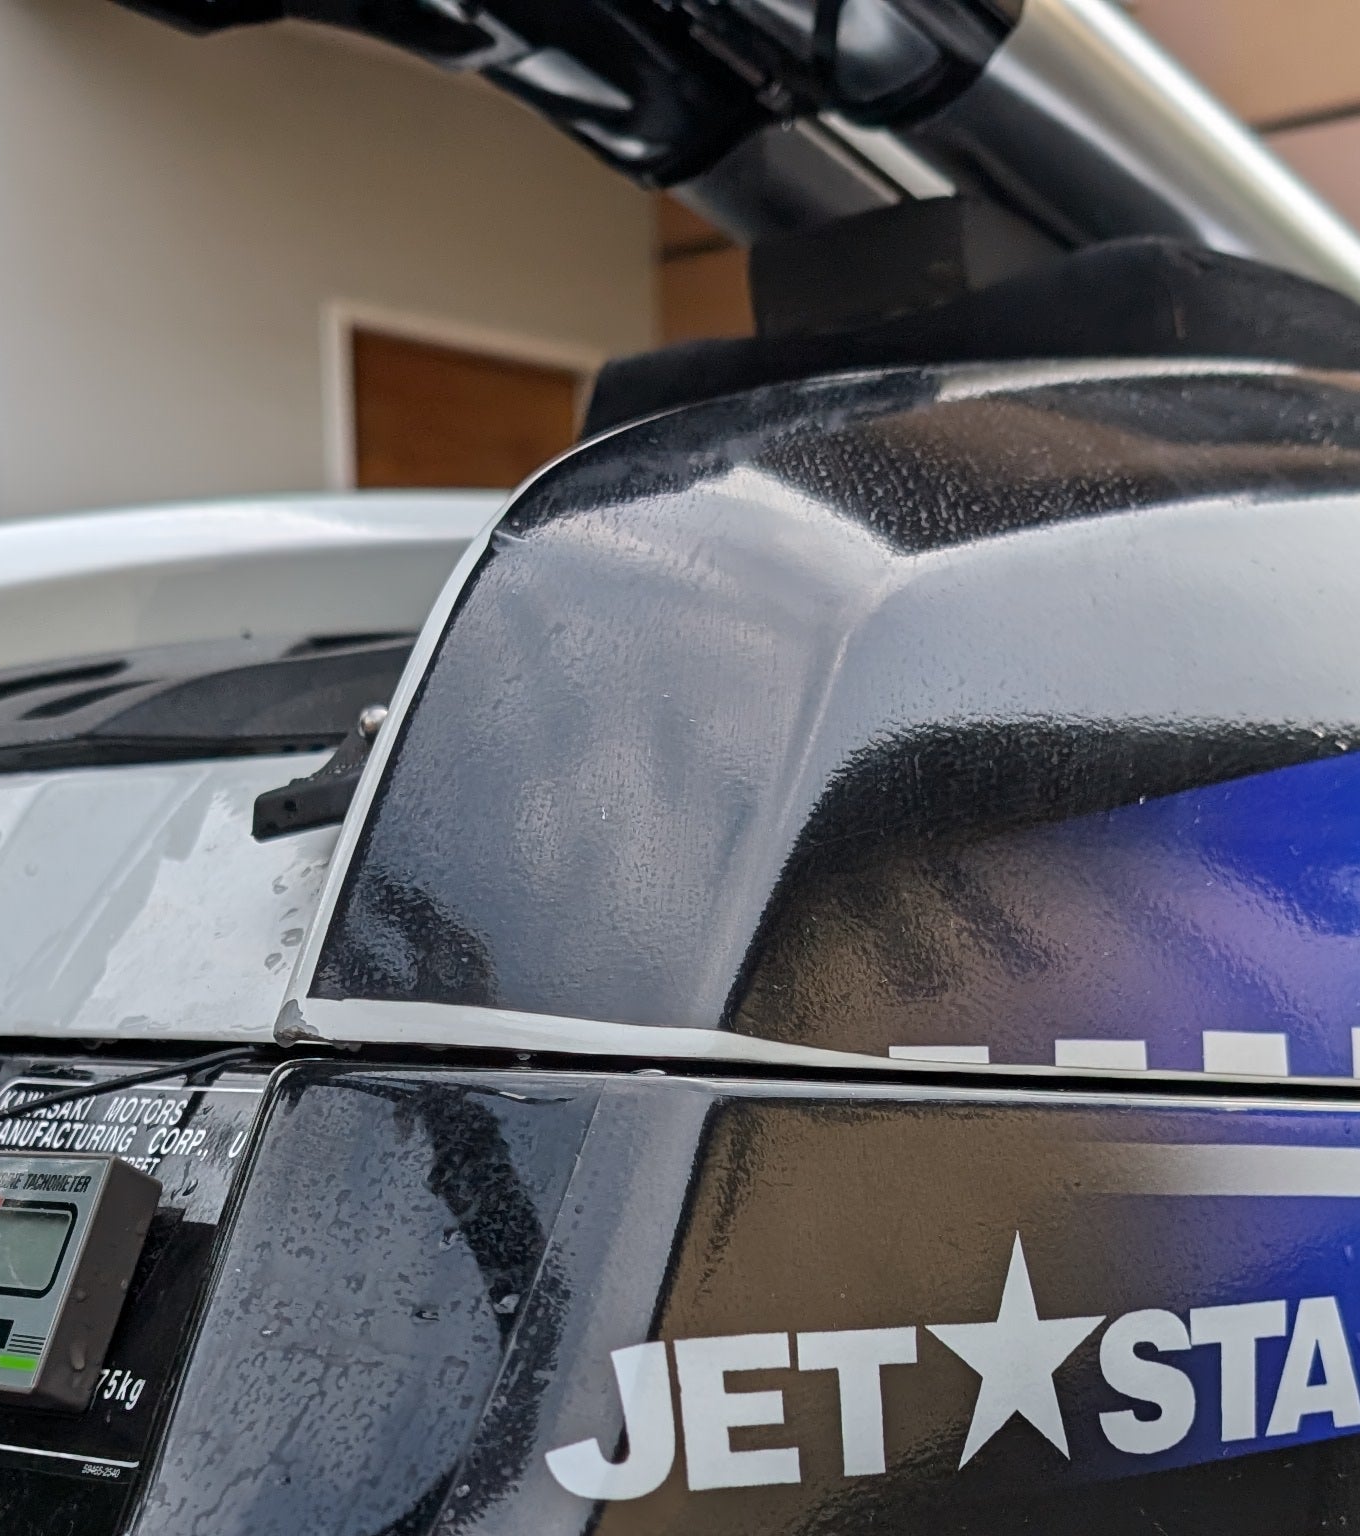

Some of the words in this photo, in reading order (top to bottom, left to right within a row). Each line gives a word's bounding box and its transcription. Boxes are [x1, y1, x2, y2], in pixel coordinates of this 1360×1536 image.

[103, 1096, 189, 1126] MOTORS
[147, 1127, 209, 1161] CORP.,
[22, 1173, 92, 1193] TACHOMETER
[544, 1330, 918, 1501] JET
